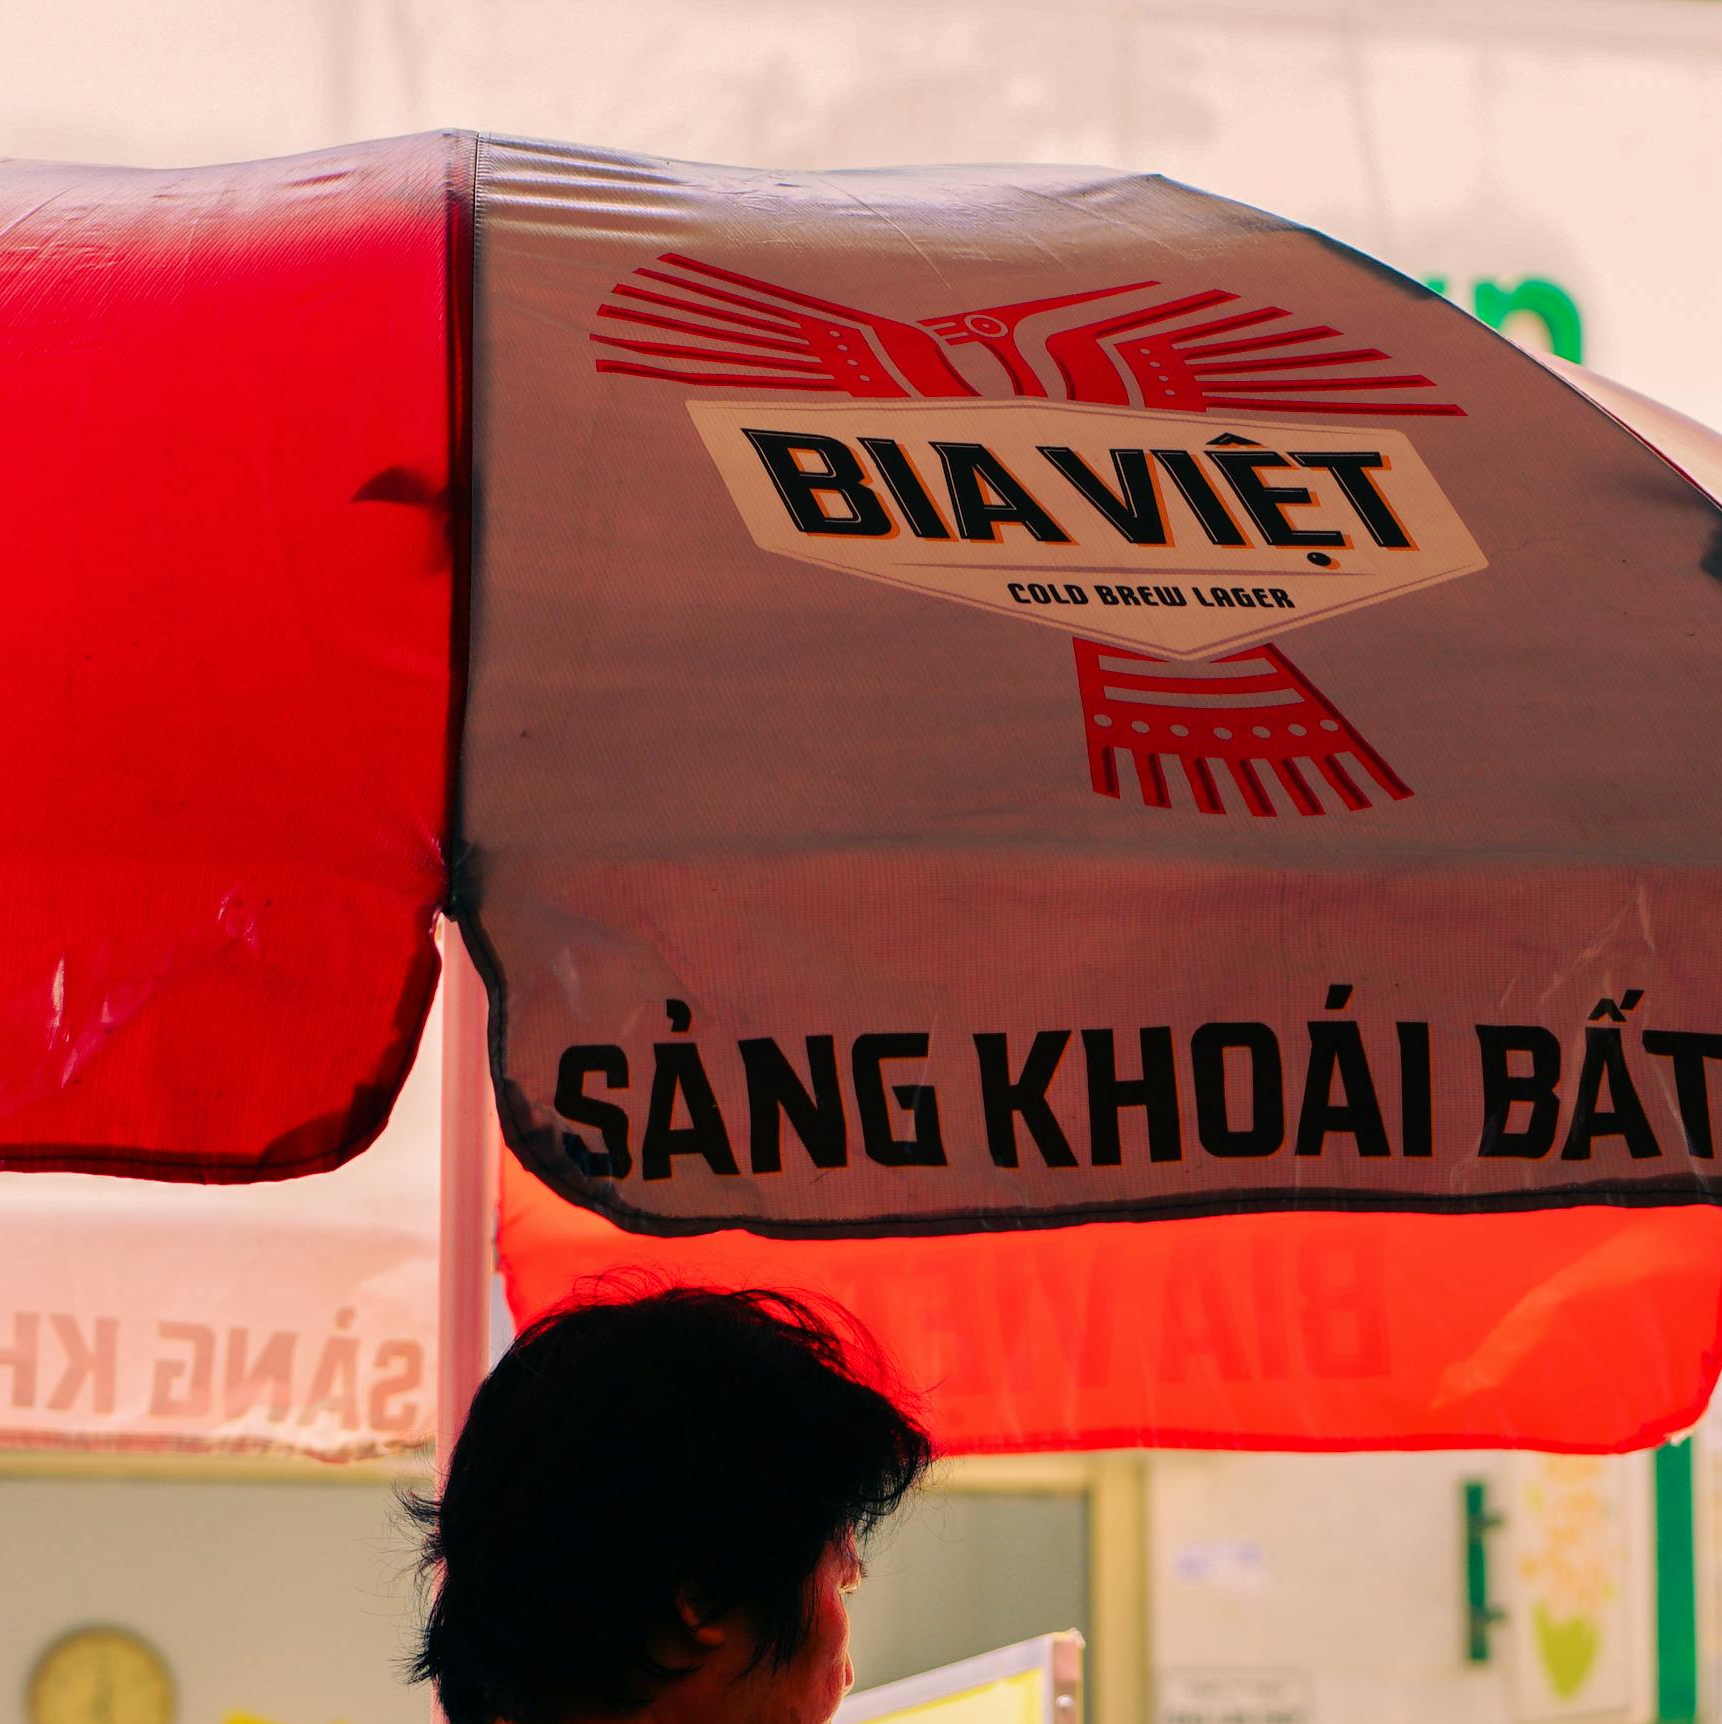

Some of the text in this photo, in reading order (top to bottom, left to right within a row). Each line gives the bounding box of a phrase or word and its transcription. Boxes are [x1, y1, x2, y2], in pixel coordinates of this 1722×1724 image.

[740, 427, 1420, 570] BIA VIỆT
[1006, 581, 1297, 609] COLD BREW LAGER
[555, 1000, 949, 1181] SẢNG
[971, 983, 1431, 1169] KHOÁI
